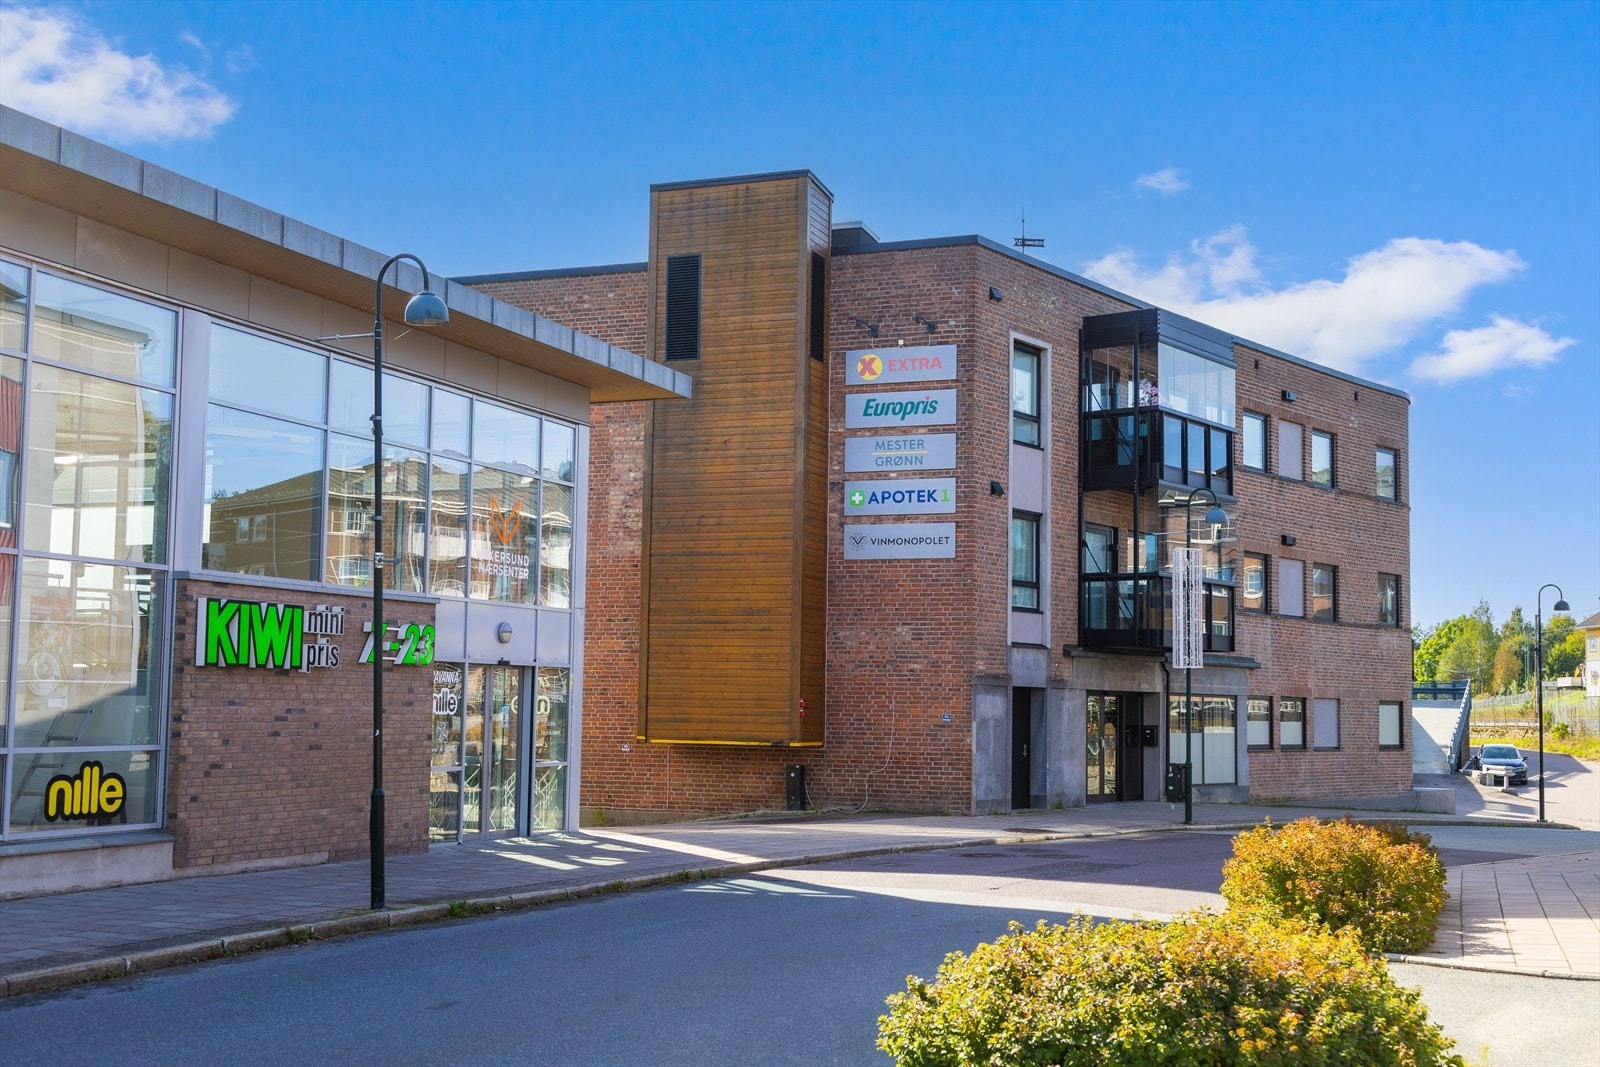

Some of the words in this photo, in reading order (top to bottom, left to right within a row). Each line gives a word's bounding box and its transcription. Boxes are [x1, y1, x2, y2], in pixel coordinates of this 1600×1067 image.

[887, 357, 943, 372] EXTRA
[862, 396, 938, 420] Europris
[874, 439, 925, 451] MESTER
[875, 455, 924, 467] GRØNN
[870, 536, 950, 546] VINMONOPOLET
[480, 549, 530, 567] KERSUND
[478, 561, 530, 580] NÆRSENTER
[307, 605, 344, 634] mini
[203, 597, 304, 669] KIWI
[306, 638, 339, 673] pris
[46, 763, 125, 819] nille
